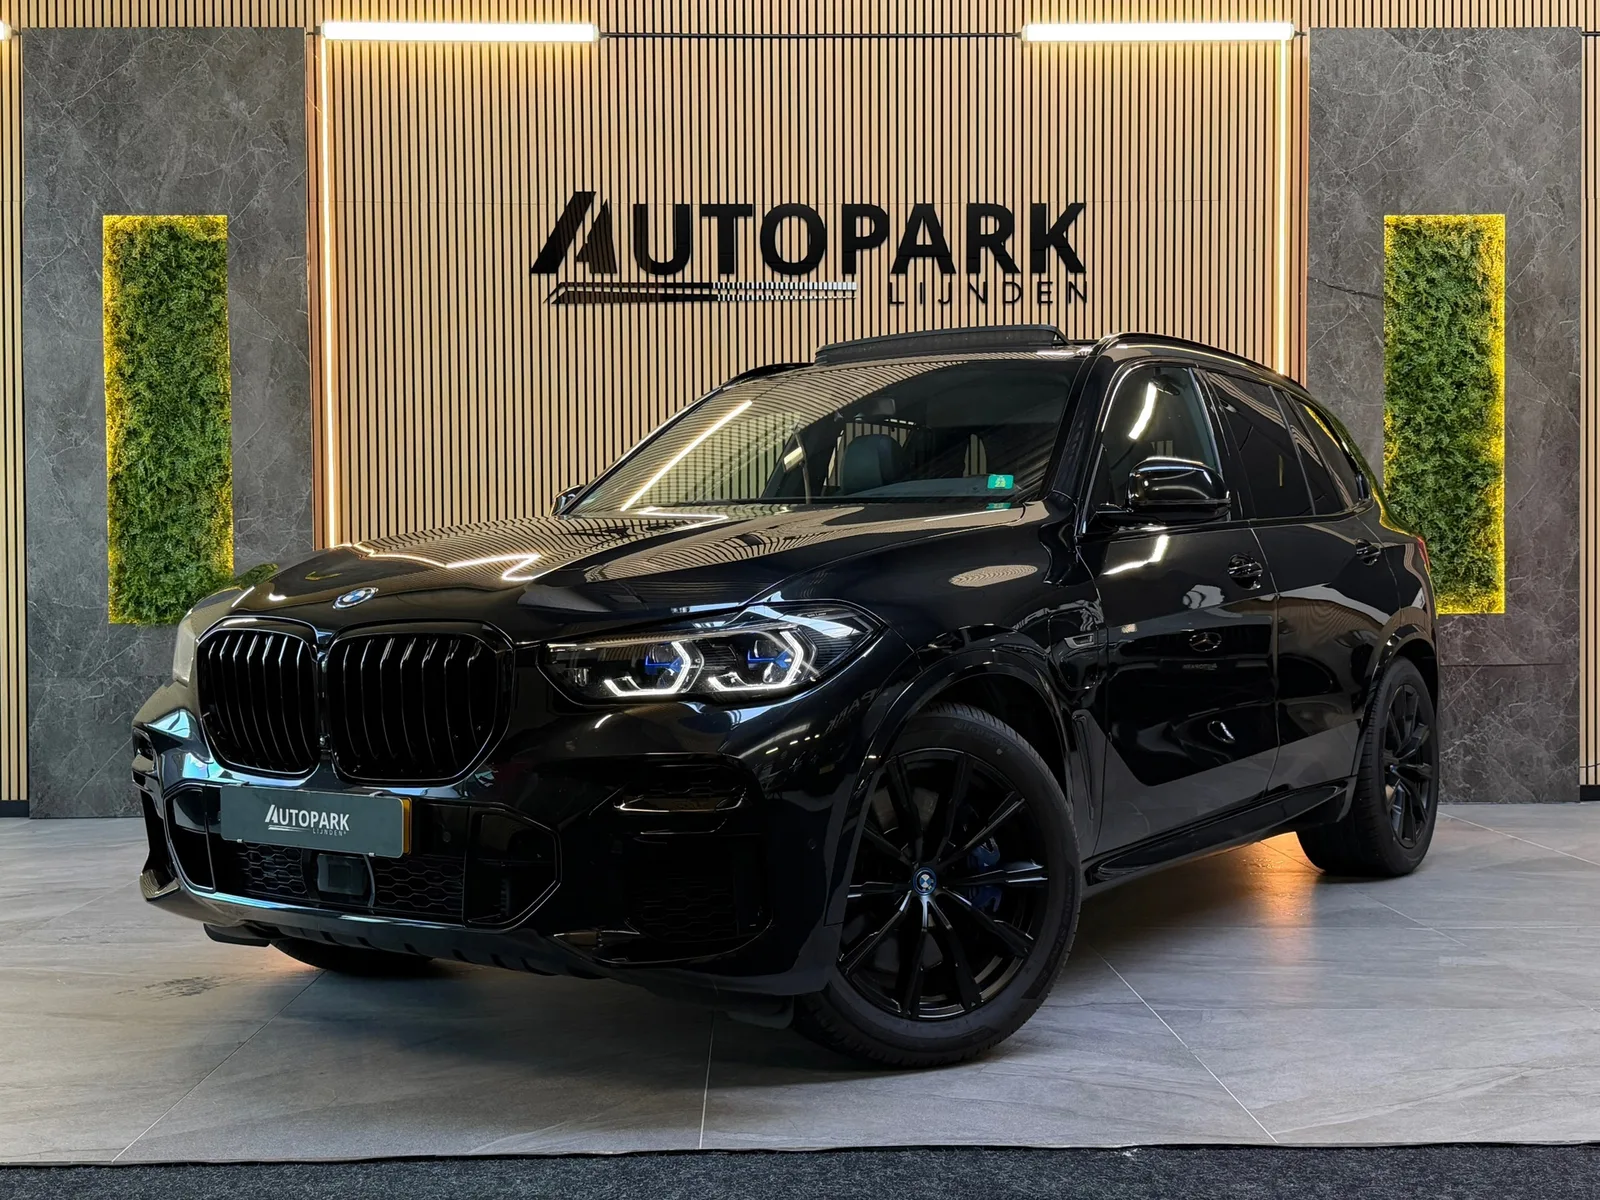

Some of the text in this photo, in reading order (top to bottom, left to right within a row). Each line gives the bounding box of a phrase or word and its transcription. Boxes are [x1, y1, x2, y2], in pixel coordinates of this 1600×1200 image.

[530, 191, 1087, 275] AUTOPARK
[889, 282, 1088, 304] LIJNDEN
[265, 804, 350, 832] AUTOPARK
